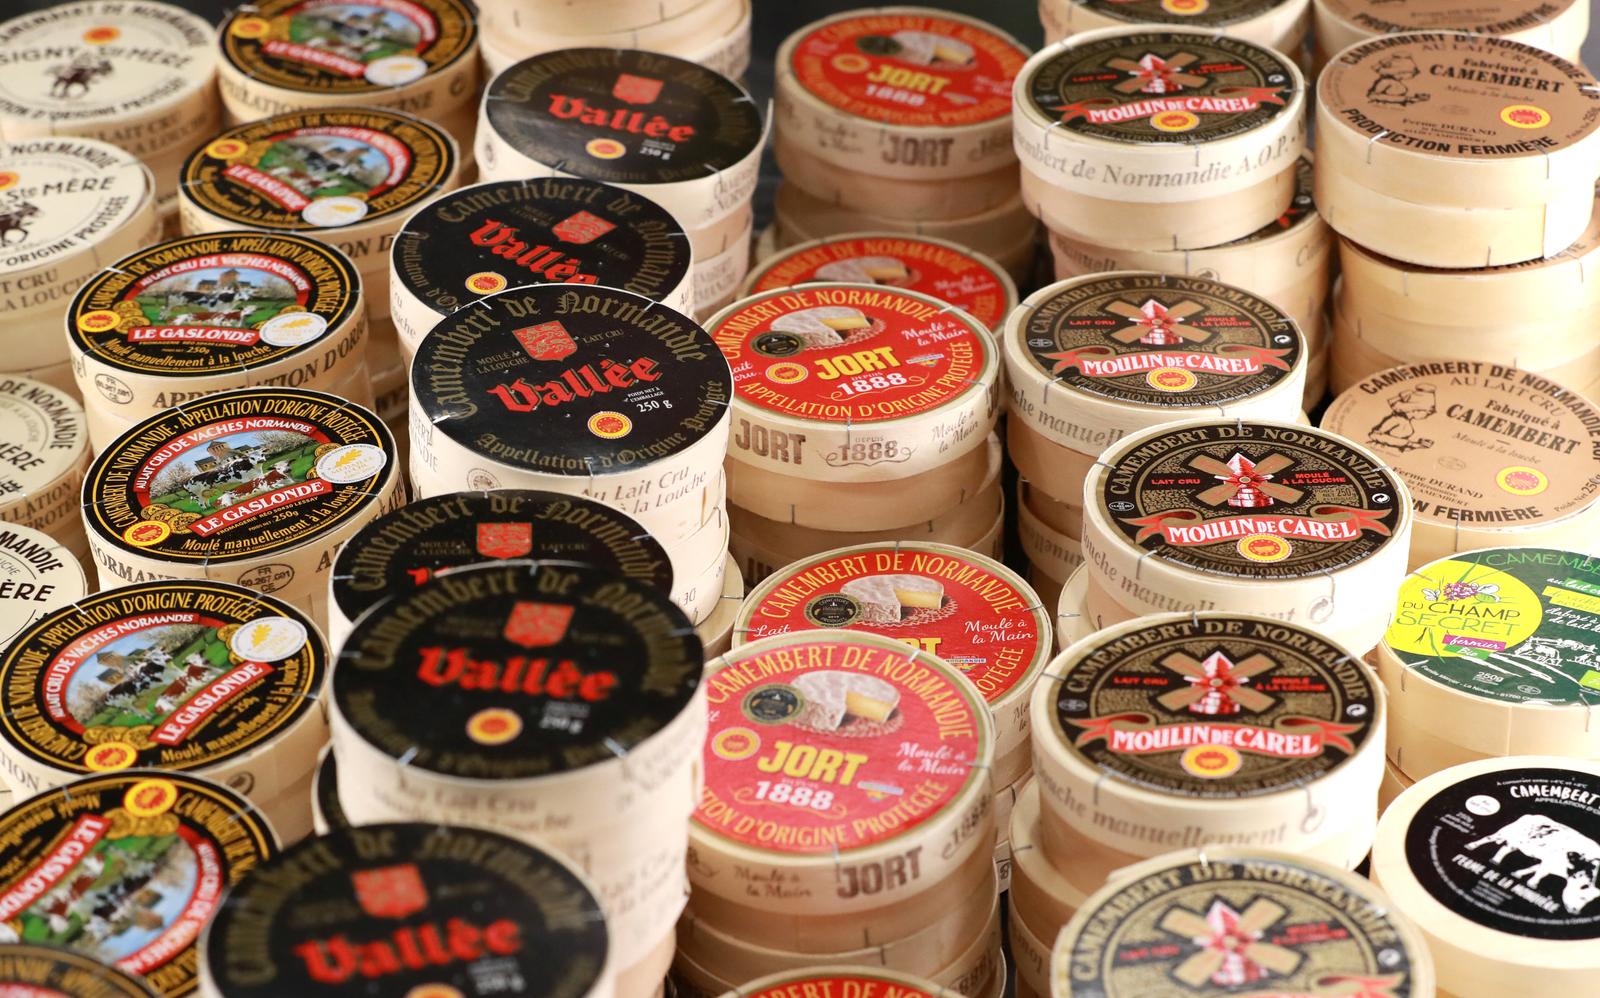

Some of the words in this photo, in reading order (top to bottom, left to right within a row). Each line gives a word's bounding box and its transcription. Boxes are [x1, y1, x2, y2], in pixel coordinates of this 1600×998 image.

[1340, 34, 1445, 65] CAMEMBERT
[1485, 35, 1588, 79] NORMANDIE
[1462, 58, 1528, 74] Fabriqué
[1530, 67, 1539, 75] à
[867, 64, 950, 94] JORT
[1429, 63, 1565, 93] CAMEMBERT
[549, 92, 696, 142] Vallée
[1088, 100, 1168, 123] MOULIN
[1168, 100, 1185, 111] DE
[1186, 96, 1257, 111] CAREL
[1340, 106, 1451, 153] PRODUCTION
[1457, 135, 1560, 155] FERMIÈRE
[881, 137, 954, 167] JORT
[1072, 159, 1096, 181] de
[1103, 158, 1232, 189] Normandie
[1236, 135, 1289, 175] A.O.P.
[42, 176, 116, 195] MÈRE
[717, 300, 783, 360] CAMEMBERT
[784, 291, 813, 311] DE
[816, 289, 941, 323] NORMANDIE
[901, 322, 945, 340] Moulé
[948, 321, 956, 329] à
[1204, 315, 1237, 323] MOULÉ
[133, 328, 157, 340] LE
[160, 328, 256, 343] GASLONDE
[186, 346, 210, 354] 250g
[582, 333, 603, 345] LAIT
[604, 328, 624, 341] CRU
[917, 336, 930, 347] la
[930, 326, 969, 344] Main
[430, 308, 501, 421] Camembert
[504, 293, 541, 318] de
[554, 290, 708, 363] Normandie
[814, 346, 905, 381] JORT
[1082, 354, 1164, 375] MOULIN
[1165, 356, 1185, 368] DE
[1185, 355, 1259, 372] CAREL
[486, 357, 663, 412] Vallée
[836, 372, 908, 396] 1888
[851, 371, 883, 382] DEPUIS
[263, 399, 328, 421] D'ORIGINE
[636, 400, 660, 413] 250
[663, 400, 673, 410] g
[1358, 362, 1484, 396] CAMEMBERT
[1489, 368, 1516, 381] DE
[1520, 373, 1600, 438] NORMANDIE
[1450, 376, 1478, 387] AU
[1483, 377, 1525, 399] LAIT
[1529, 393, 1568, 418] CRU
[178, 399, 262, 429] APPELLATION
[320, 408, 370, 444] PROTÉGÉE
[475, 433, 590, 470] Appellation
[601, 430, 687, 469] d'Origine
[681, 379, 725, 432] Protégée
[1484, 400, 1552, 428] Fabriqué
[1554, 420, 1561, 430] à
[151, 449, 172, 467] CRU
[172, 438, 191, 452] DE
[187, 420, 244, 442] VACHES
[245, 420, 312, 432] NORMANDES
[735, 419, 806, 465] JORT
[854, 435, 884, 443] DEPUIS
[1445, 403, 1581, 456] CAMEMBERT
[112, 424, 176, 470] NORMANDIE
[839, 440, 899, 462] 1888
[1110, 427, 1208, 496] CAMEMBERT
[1218, 426, 1255, 440] DE
[1262, 427, 1388, 490] NORMANDIE
[105, 472, 131, 486] DE
[616, 479, 652, 501] Lait
[658, 466, 690, 489] Cru
[1295, 471, 1329, 479] MOULÉ
[1306, 476, 1346, 484] LOUCHE
[103, 485, 139, 528] CAMEMBERT
[196, 518, 224, 533] LE
[222, 481, 325, 522] GASLONDE
[323, 485, 358, 509] louche
[305, 514, 320, 523] à
[312, 506, 331, 518] la
[1433, 505, 1544, 524] FERMIÈRE
[181, 537, 220, 551] Moulé
[224, 520, 305, 549] manuellement
[352, 496, 474, 591] Camembert
[488, 494, 522, 514] de
[536, 501, 666, 585] Normandi
[1168, 519, 1255, 544] MOULIN
[1256, 521, 1278, 534] DE
[1278, 519, 1357, 540] CAREL
[760, 555, 869, 619] CAMEMBERT
[875, 554, 904, 573] DE
[910, 554, 1024, 615] NORMANDIE
[1402, 601, 1424, 610] DU
[1428, 602, 1521, 621] CHAMP
[38, 601, 120, 649] APPELLATION
[122, 592, 193, 614] D'ORIGINE
[196, 594, 263, 622] PROTÉGÉE
[120, 613, 194, 633] NORMANDES
[964, 617, 1015, 635] Moulé
[1017, 619, 1027, 628] à
[1396, 610, 1521, 636] SECRET
[65, 627, 118, 659] VACHES
[971, 634, 987, 645] la
[990, 629, 1034, 642] Main
[1448, 636, 1501, 651] fermier
[57, 658, 76, 674] DE
[1066, 623, 1193, 693] CAMEMBERT
[1203, 621, 1245, 635] DE
[1251, 622, 1368, 701] NORMANDIE
[1461, 646, 1479, 658] Bio
[47, 673, 65, 692] CRU
[416, 647, 618, 701] Vallée
[1476, 671, 1505, 683] 250g
[158, 723, 186, 741] LE
[175, 663, 264, 725] GASLONDE
[706, 646, 837, 705] CAMEMBERT
[842, 646, 879, 671] DE
[878, 653, 974, 742] NORMANDIE
[1112, 726, 1210, 752] MOULIN
[1211, 728, 1234, 745] DE
[1234, 728, 1320, 755] CAREL
[756, 741, 869, 786] JORT
[754, 780, 835, 811] 1888
[1510, 785, 1600, 806] CAMEMBERT
[733, 813, 848, 846] D'ORIGINE
[852, 776, 950, 835] PROTÉGÉE
[837, 846, 924, 900] JORT
[293, 916, 524, 984] Vallée
